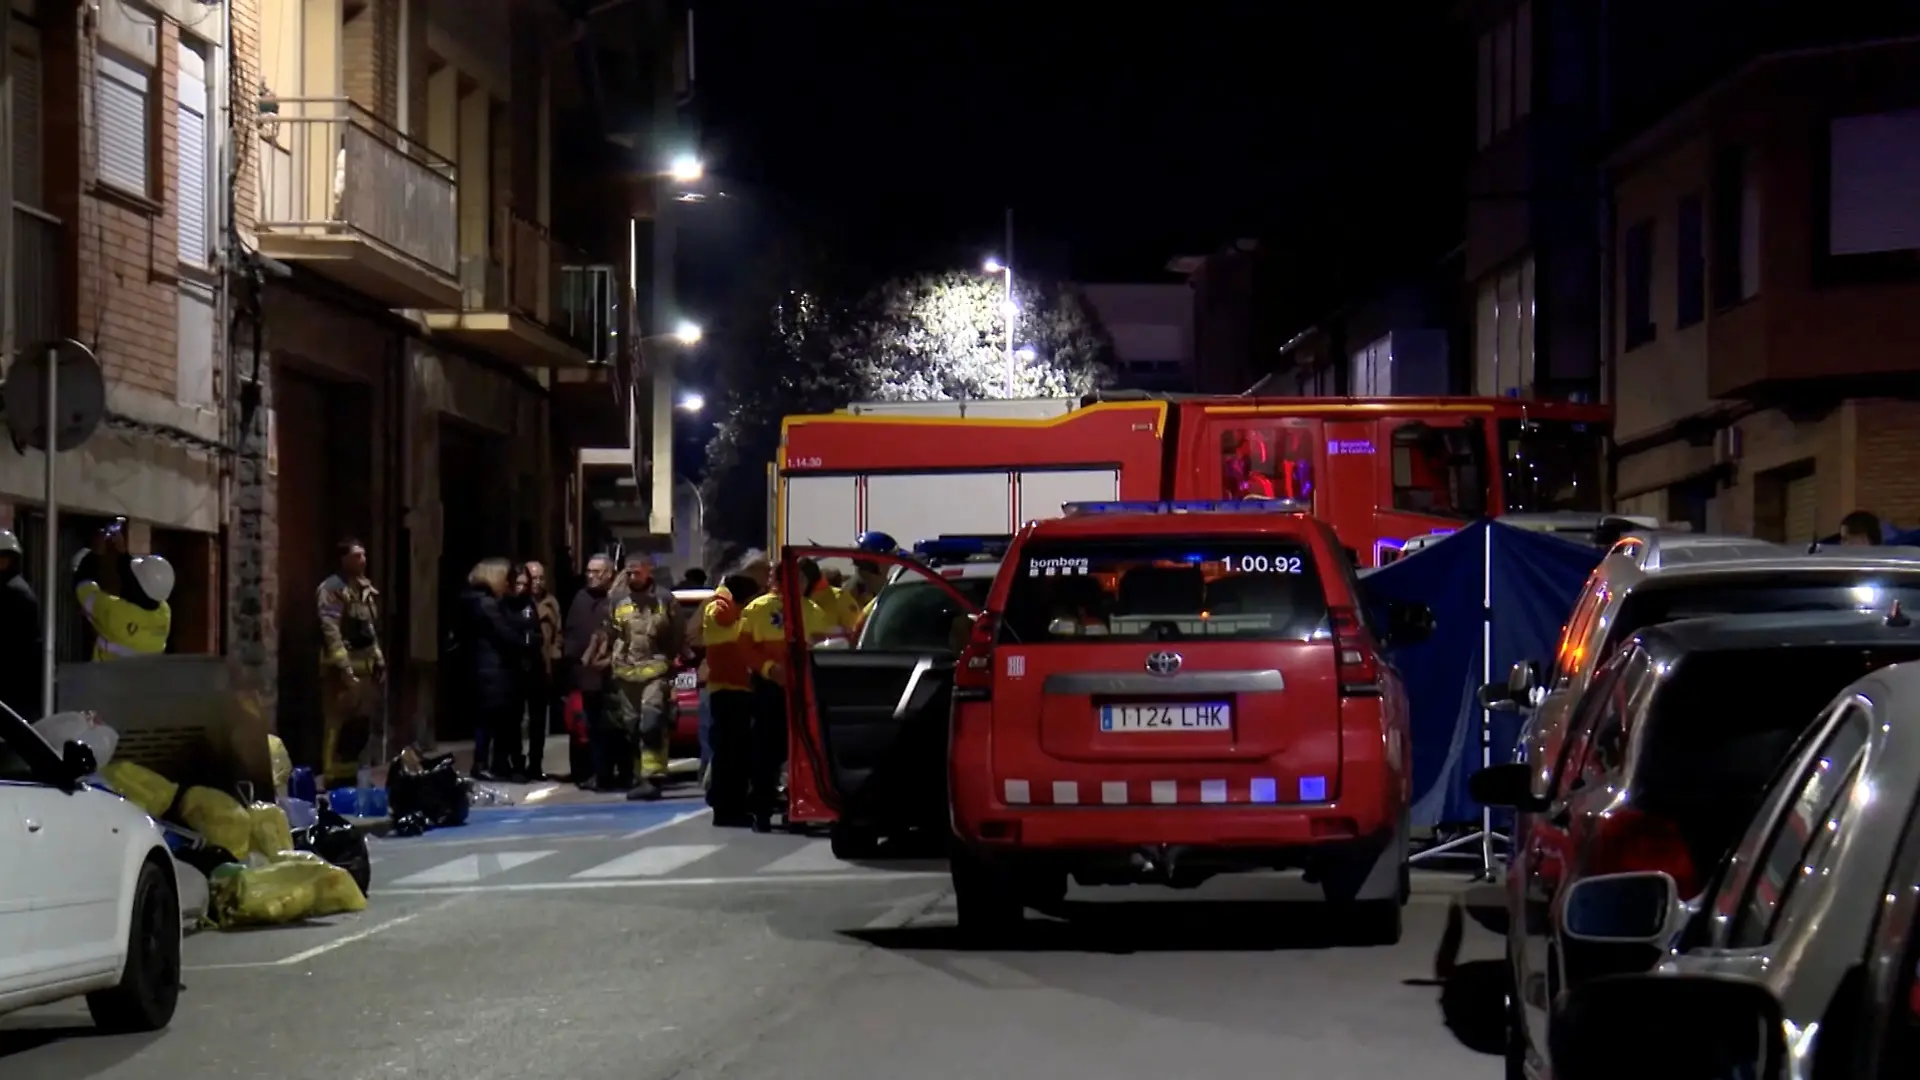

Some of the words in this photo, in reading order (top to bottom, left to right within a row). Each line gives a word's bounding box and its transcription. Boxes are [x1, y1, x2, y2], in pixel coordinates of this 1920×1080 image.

[1030, 557, 1088, 567] bombers
[1221, 555, 1301, 573] 1.00.92
[1121, 706, 1172, 727] 1124
[1181, 705, 1222, 727] LHK
